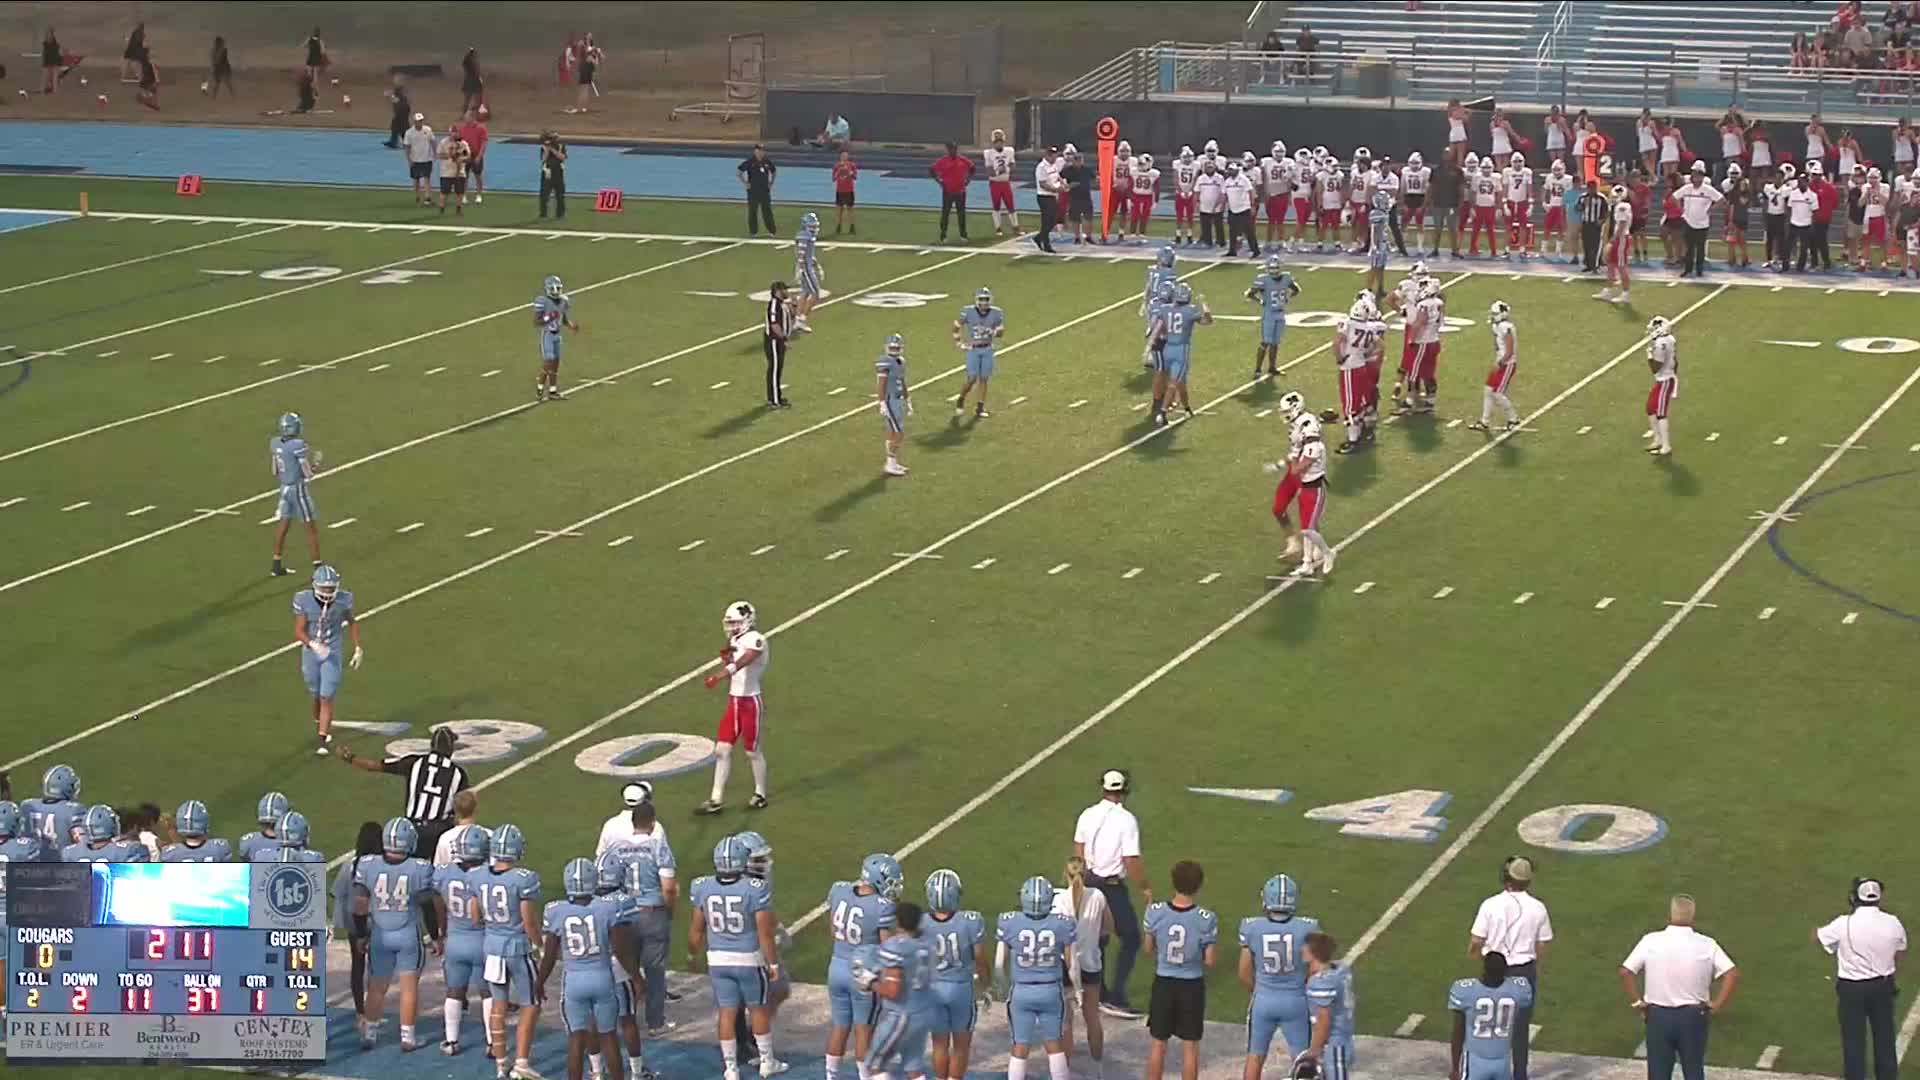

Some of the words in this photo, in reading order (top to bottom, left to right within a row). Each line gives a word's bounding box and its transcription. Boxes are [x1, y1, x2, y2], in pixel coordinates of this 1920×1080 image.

[1599, 154, 1612, 174] 2
[1167, 312, 1184, 334] 12
[1352, 328, 1375, 350] 70
[422, 765, 443, 795] L
[374, 872, 410, 912] 44
[479, 882, 509, 924] 13
[706, 894, 745, 934] 65
[832, 900, 865, 946] 46
[563, 914, 601, 957] 61
[1017, 928, 1057, 969] 32
[1166, 923, 1187, 964] 2
[1261, 933, 1297, 974] 51
[1472, 997, 1516, 1039] 20
